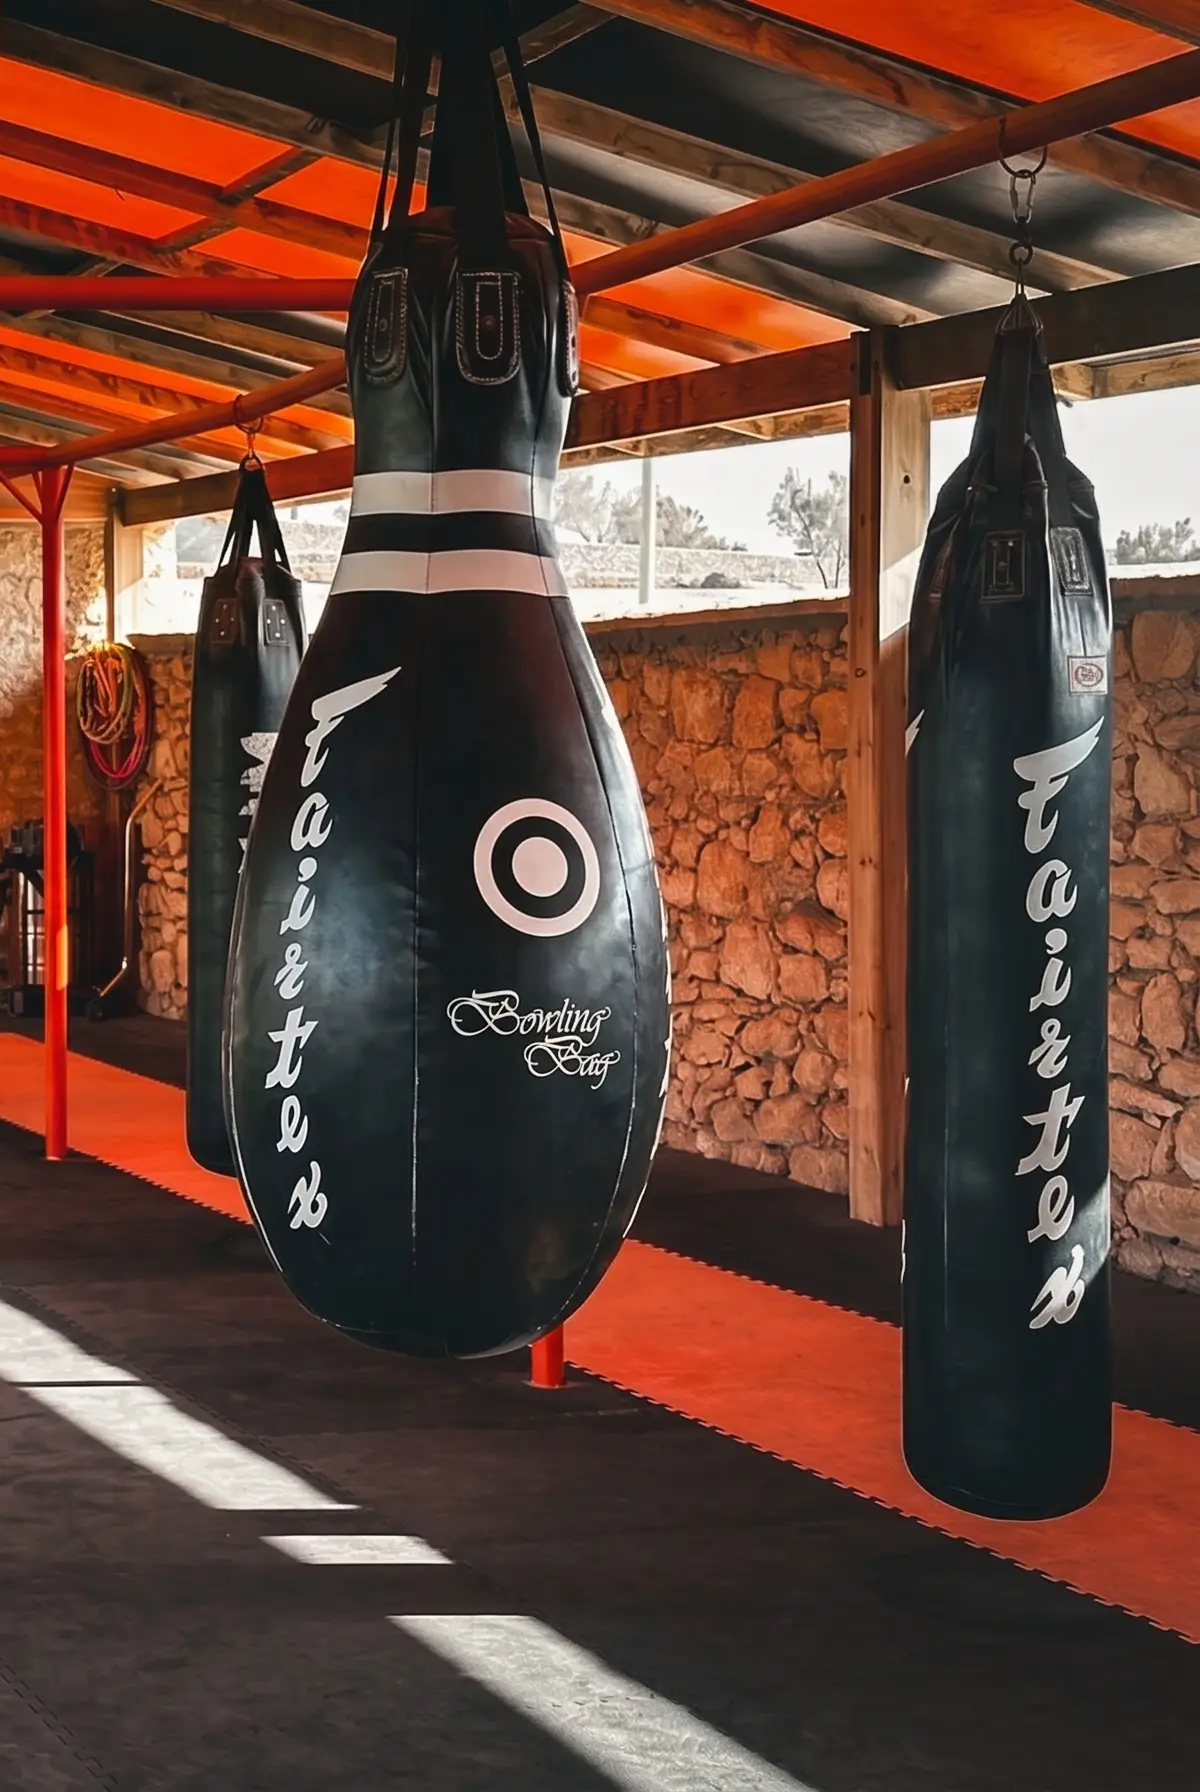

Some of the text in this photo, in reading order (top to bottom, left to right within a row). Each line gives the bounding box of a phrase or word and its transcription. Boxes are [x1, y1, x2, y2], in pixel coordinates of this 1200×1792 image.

[266, 666, 402, 1229] Fairtex
[447, 989, 611, 1047] Bowling
[524, 1035, 621, 1090] Bag
[1014, 716, 1105, 1330] Fairtex
